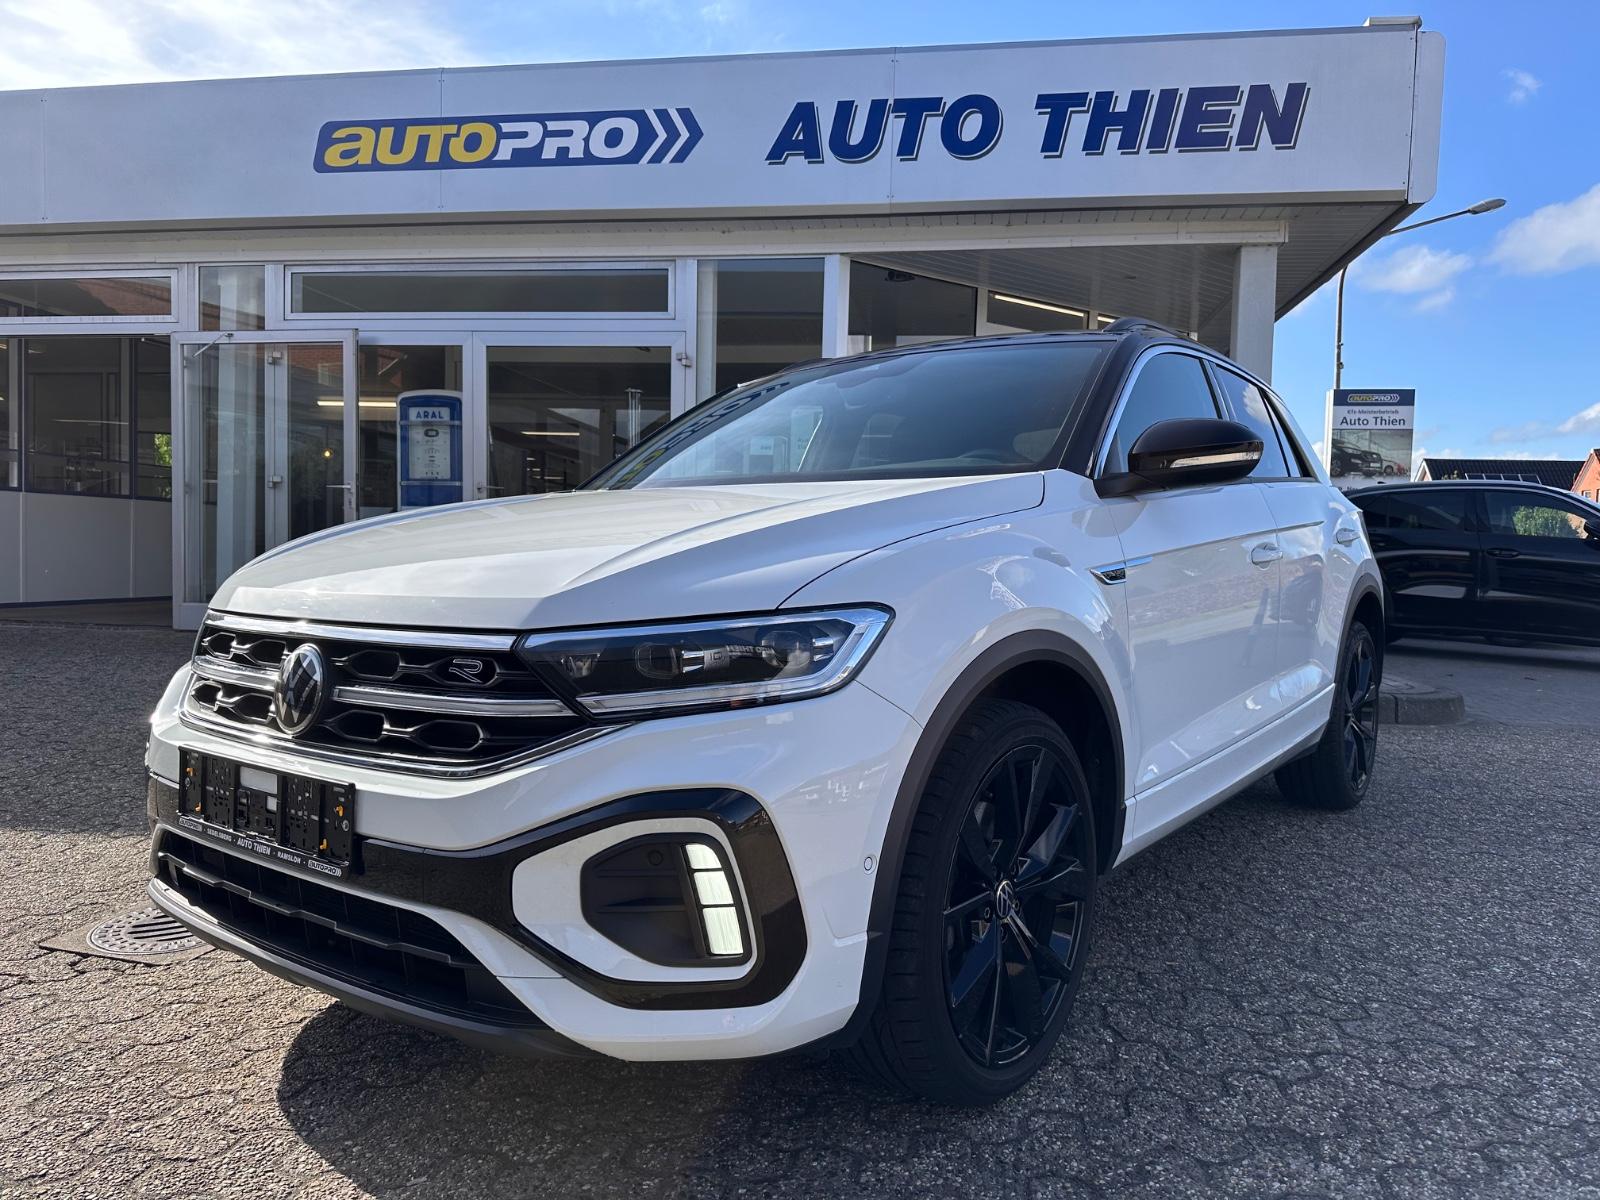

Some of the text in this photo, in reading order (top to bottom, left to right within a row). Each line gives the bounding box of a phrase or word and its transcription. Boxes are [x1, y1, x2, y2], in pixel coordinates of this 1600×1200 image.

[765, 82, 1310, 165] AUTO THIEN
[415, 410, 445, 419] ARAL
[1340, 416, 1406, 426] Auto Thien
[237, 838, 253, 850] AUTO
[253, 842, 271, 855] THIEN
